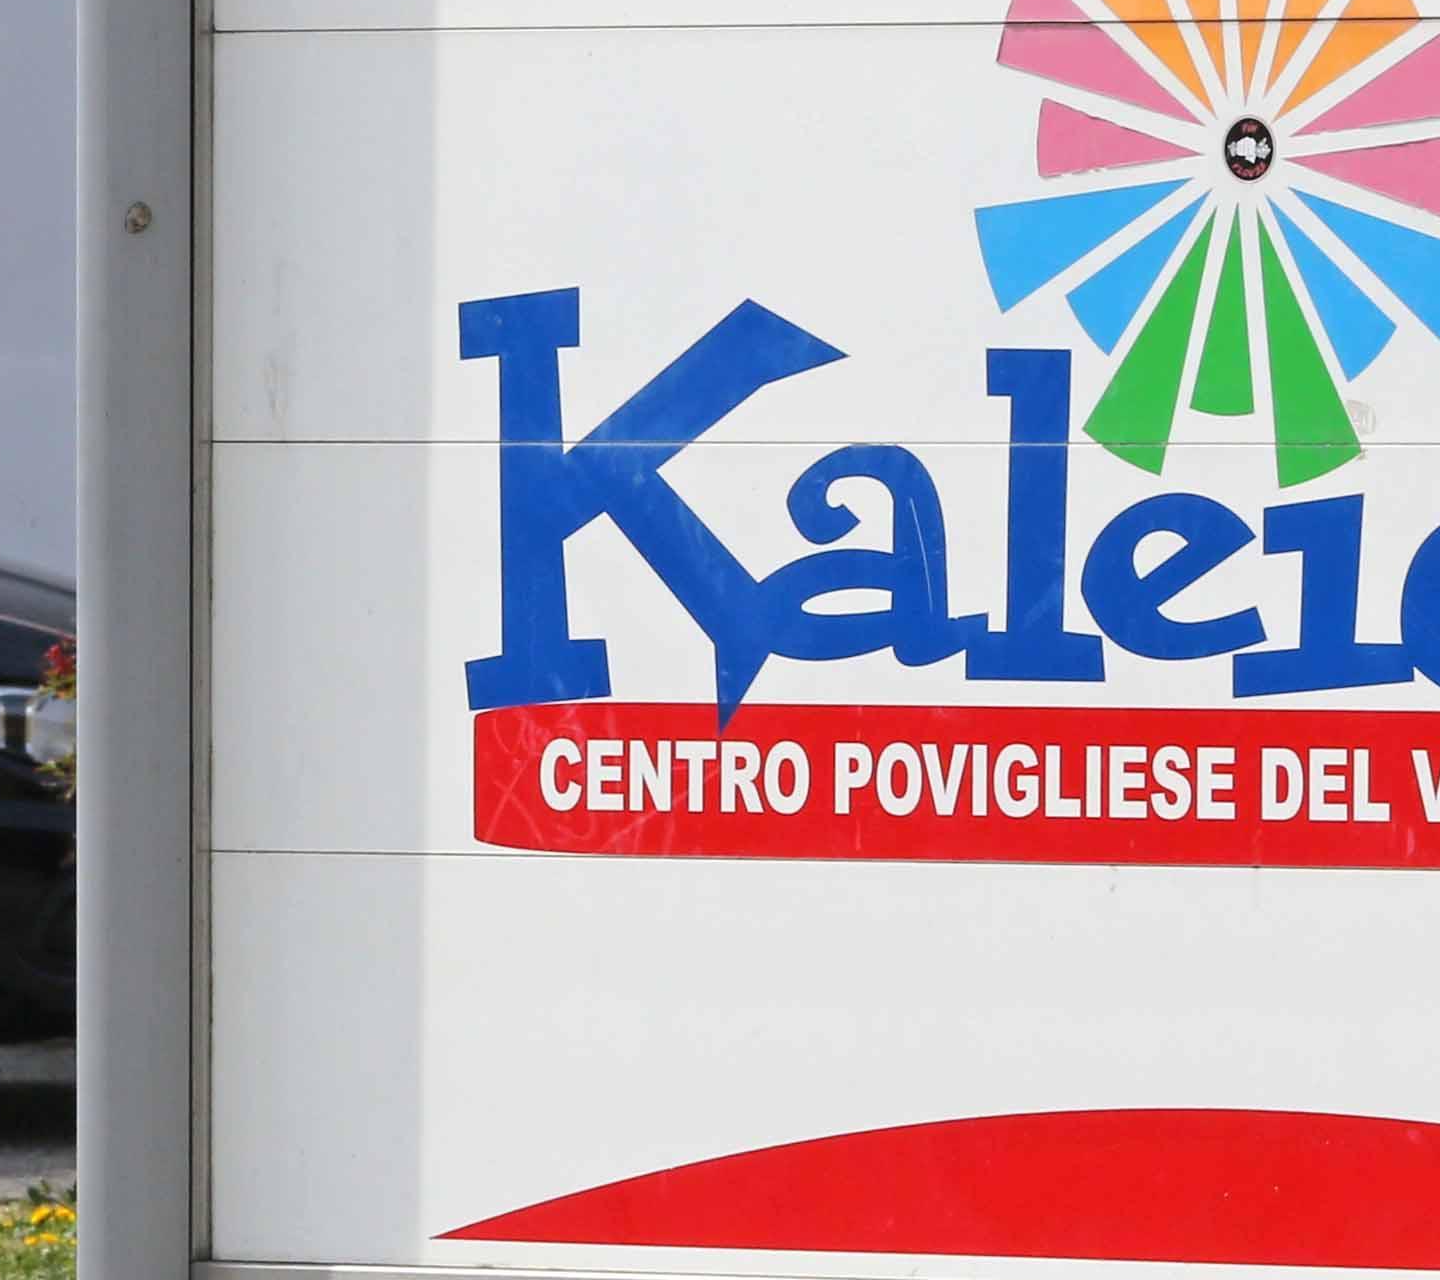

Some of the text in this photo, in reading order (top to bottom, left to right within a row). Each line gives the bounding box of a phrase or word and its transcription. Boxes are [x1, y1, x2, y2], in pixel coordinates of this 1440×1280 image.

[538, 736, 811, 816] CENTRO
[833, 741, 1237, 821] POVIGLIESE
[1260, 746, 1392, 824] DEL
